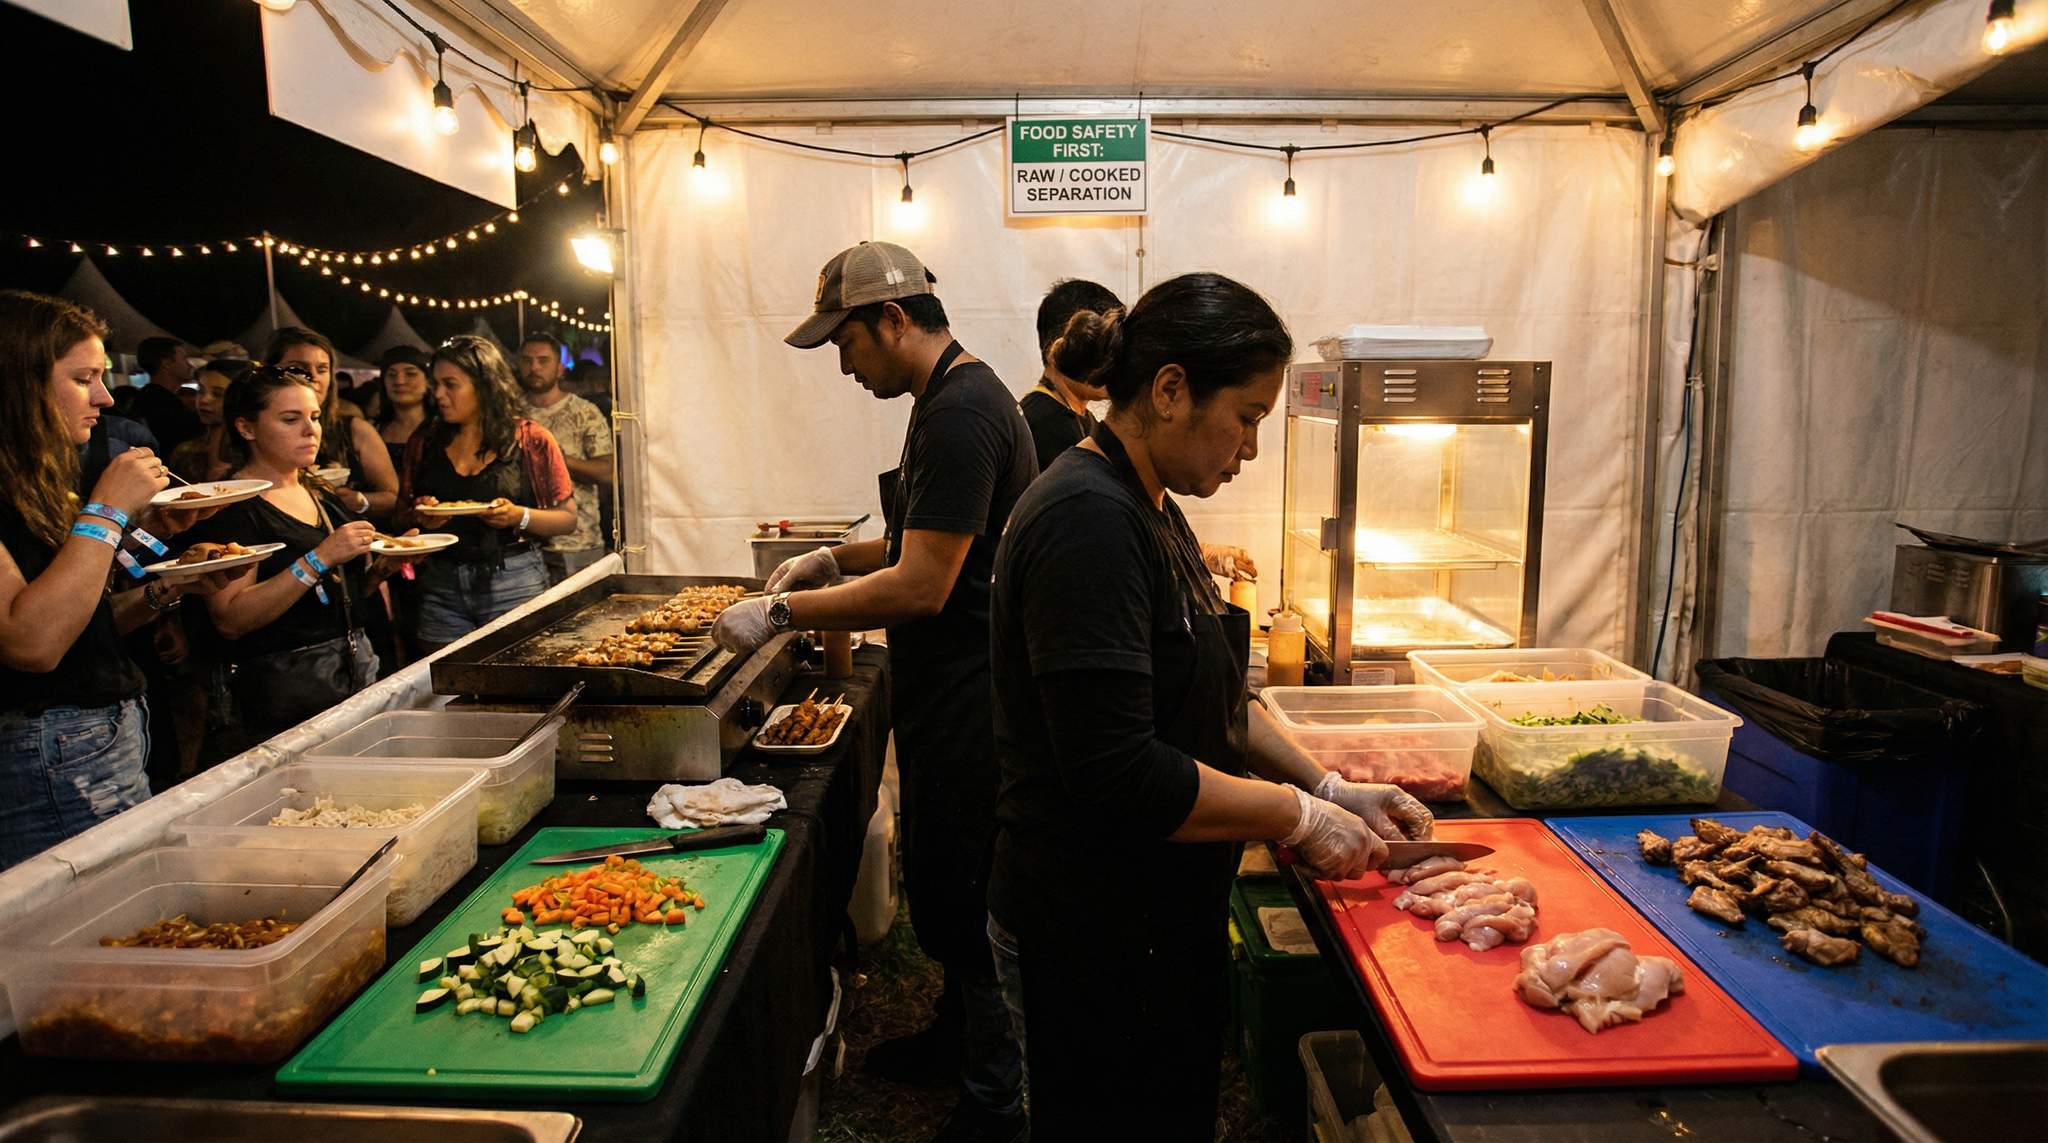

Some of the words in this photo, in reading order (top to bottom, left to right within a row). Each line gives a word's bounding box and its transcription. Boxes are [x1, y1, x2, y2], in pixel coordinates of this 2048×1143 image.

[1020, 126, 1067, 140] FOOD
[1072, 125, 1137, 139] SAFETY
[1053, 143, 1104, 157] FIRST:
[1017, 169, 1055, 183] RAW
[1069, 168, 1141, 182] COOKED
[1027, 187, 1132, 201] SEPARATION
